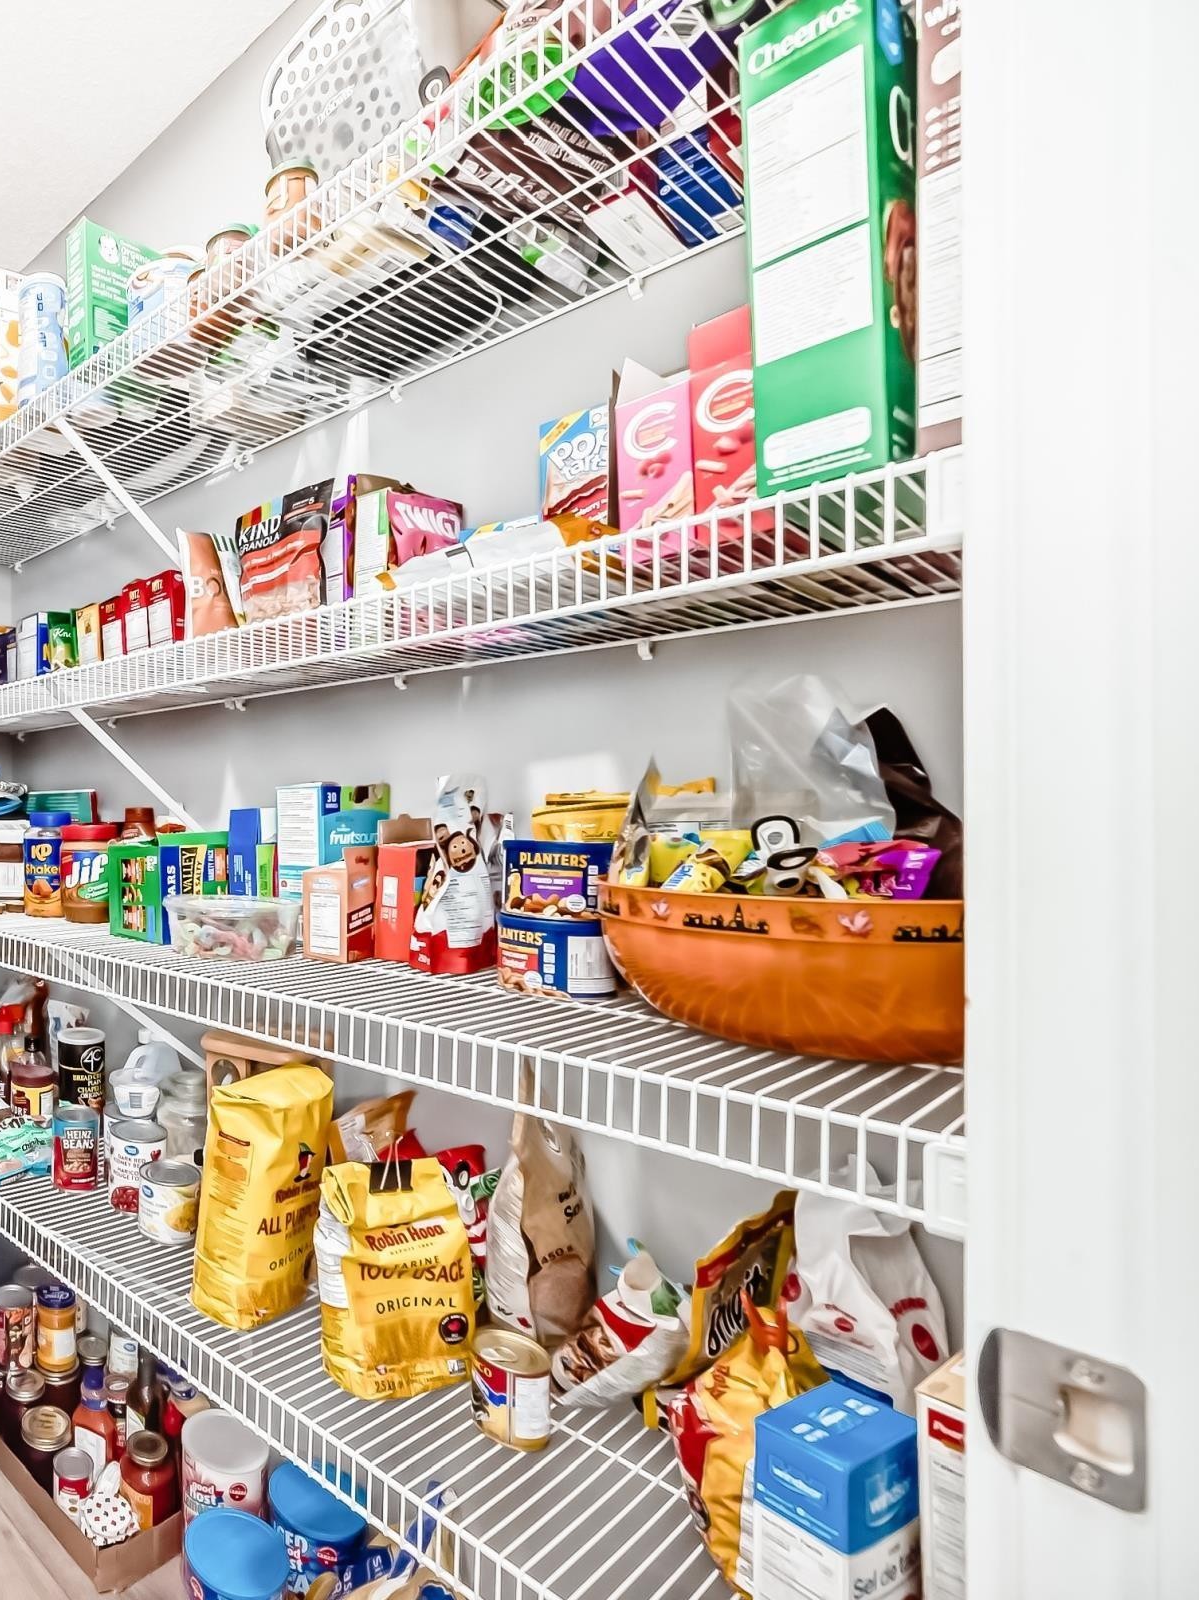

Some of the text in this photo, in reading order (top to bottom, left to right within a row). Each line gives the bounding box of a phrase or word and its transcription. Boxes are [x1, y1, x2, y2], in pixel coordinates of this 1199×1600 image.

[239, 514, 282, 546] KIND
[25, 864, 60, 876] Shake
[65, 853, 109, 888] Jif
[182, 850, 198, 892] VALLEY
[519, 851, 589, 869] PLANTERS
[166, 865, 178, 897] ARS
[83, 1048, 102, 1072] 4C
[62, 1139, 95, 1150] BEANS
[66, 1130, 93, 1140] HEINZ
[257, 1216, 282, 1236] ALL
[365, 1230, 409, 1252] Robin
[269, 1243, 313, 1271] ORIGINA
[376, 1297, 457, 1314] ORIGINAL
